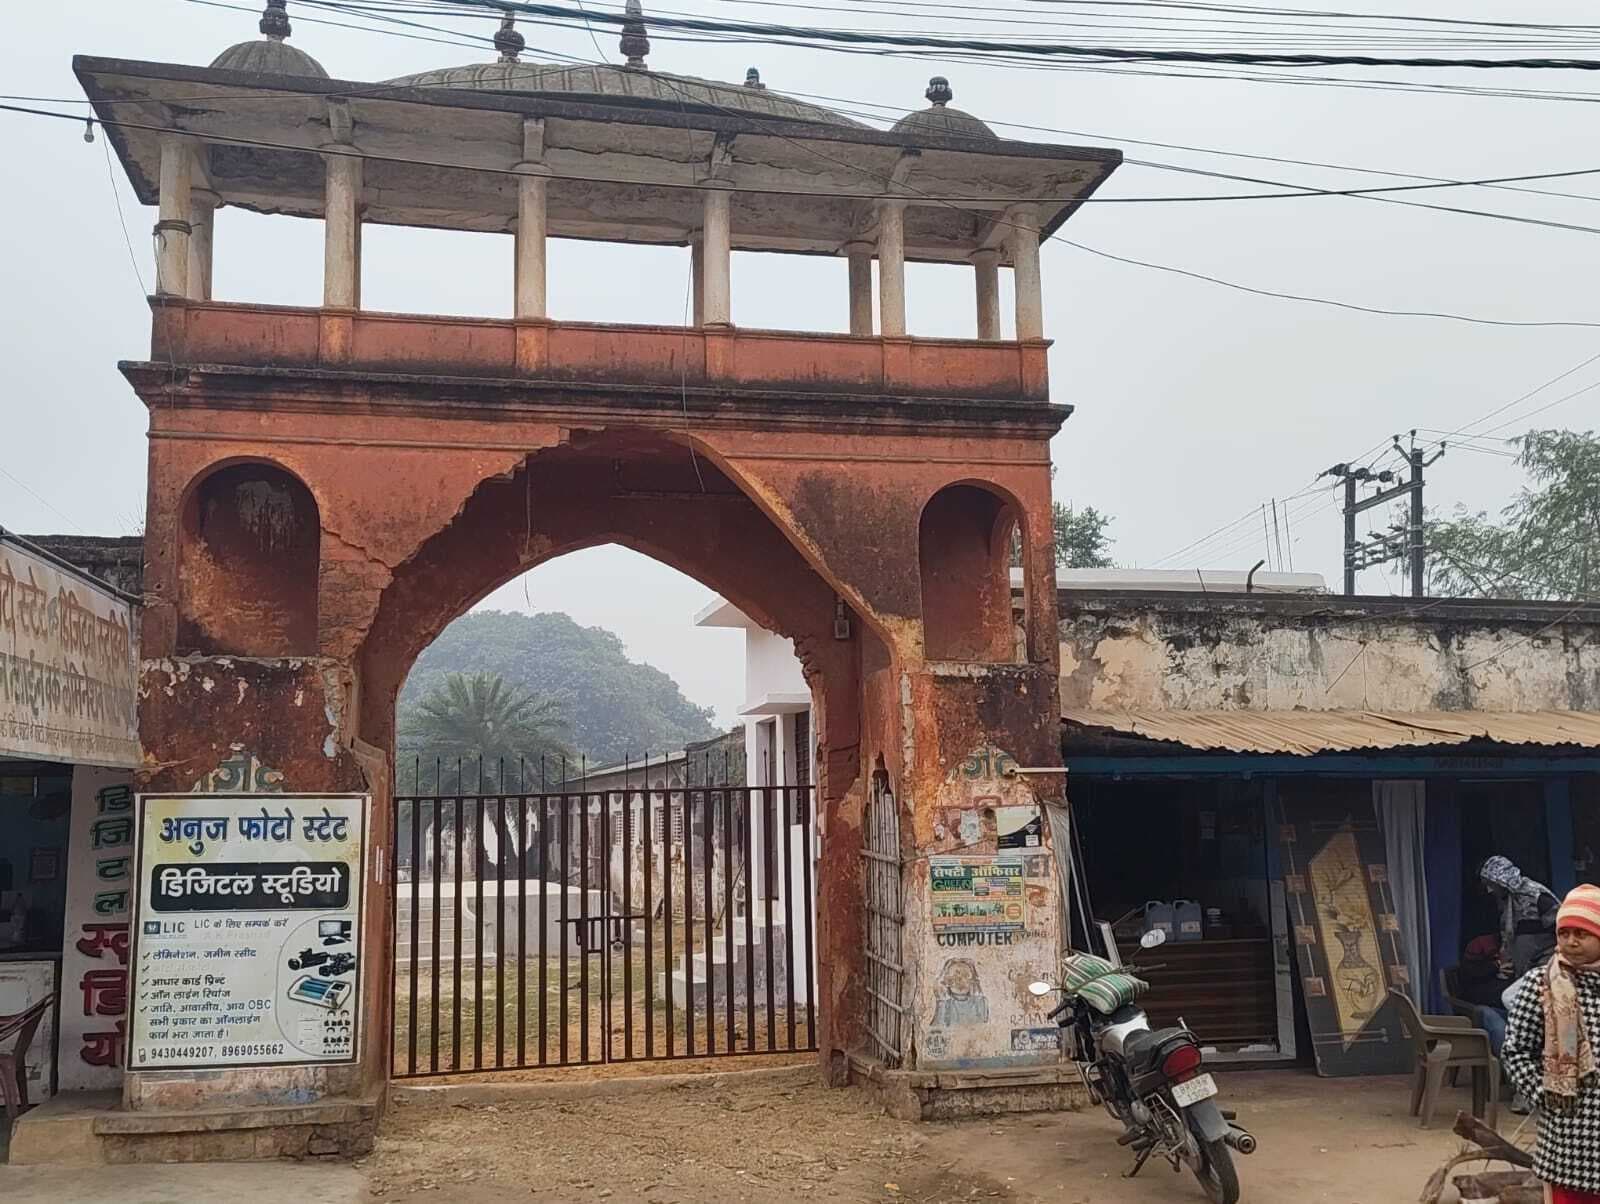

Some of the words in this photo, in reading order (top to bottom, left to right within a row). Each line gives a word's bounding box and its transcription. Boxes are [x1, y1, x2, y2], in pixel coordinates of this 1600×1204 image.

[160, 816, 230, 855] अनुज
[238, 806, 294, 841] फोटो
[302, 806, 349, 841] स्टेट
[160, 867, 256, 897] डिजिटल
[261, 865, 343, 903] स्टूडियो
[163, 921, 186, 934] LIC
[194, 919, 210, 929] LIC
[936, 931, 1013, 947] COMPUTER
[151, 977, 179, 987] आधार
[181, 974, 202, 987] कार्ड
[248, 1000, 272, 1010] OBC
[200, 1016, 212, 1026] का
